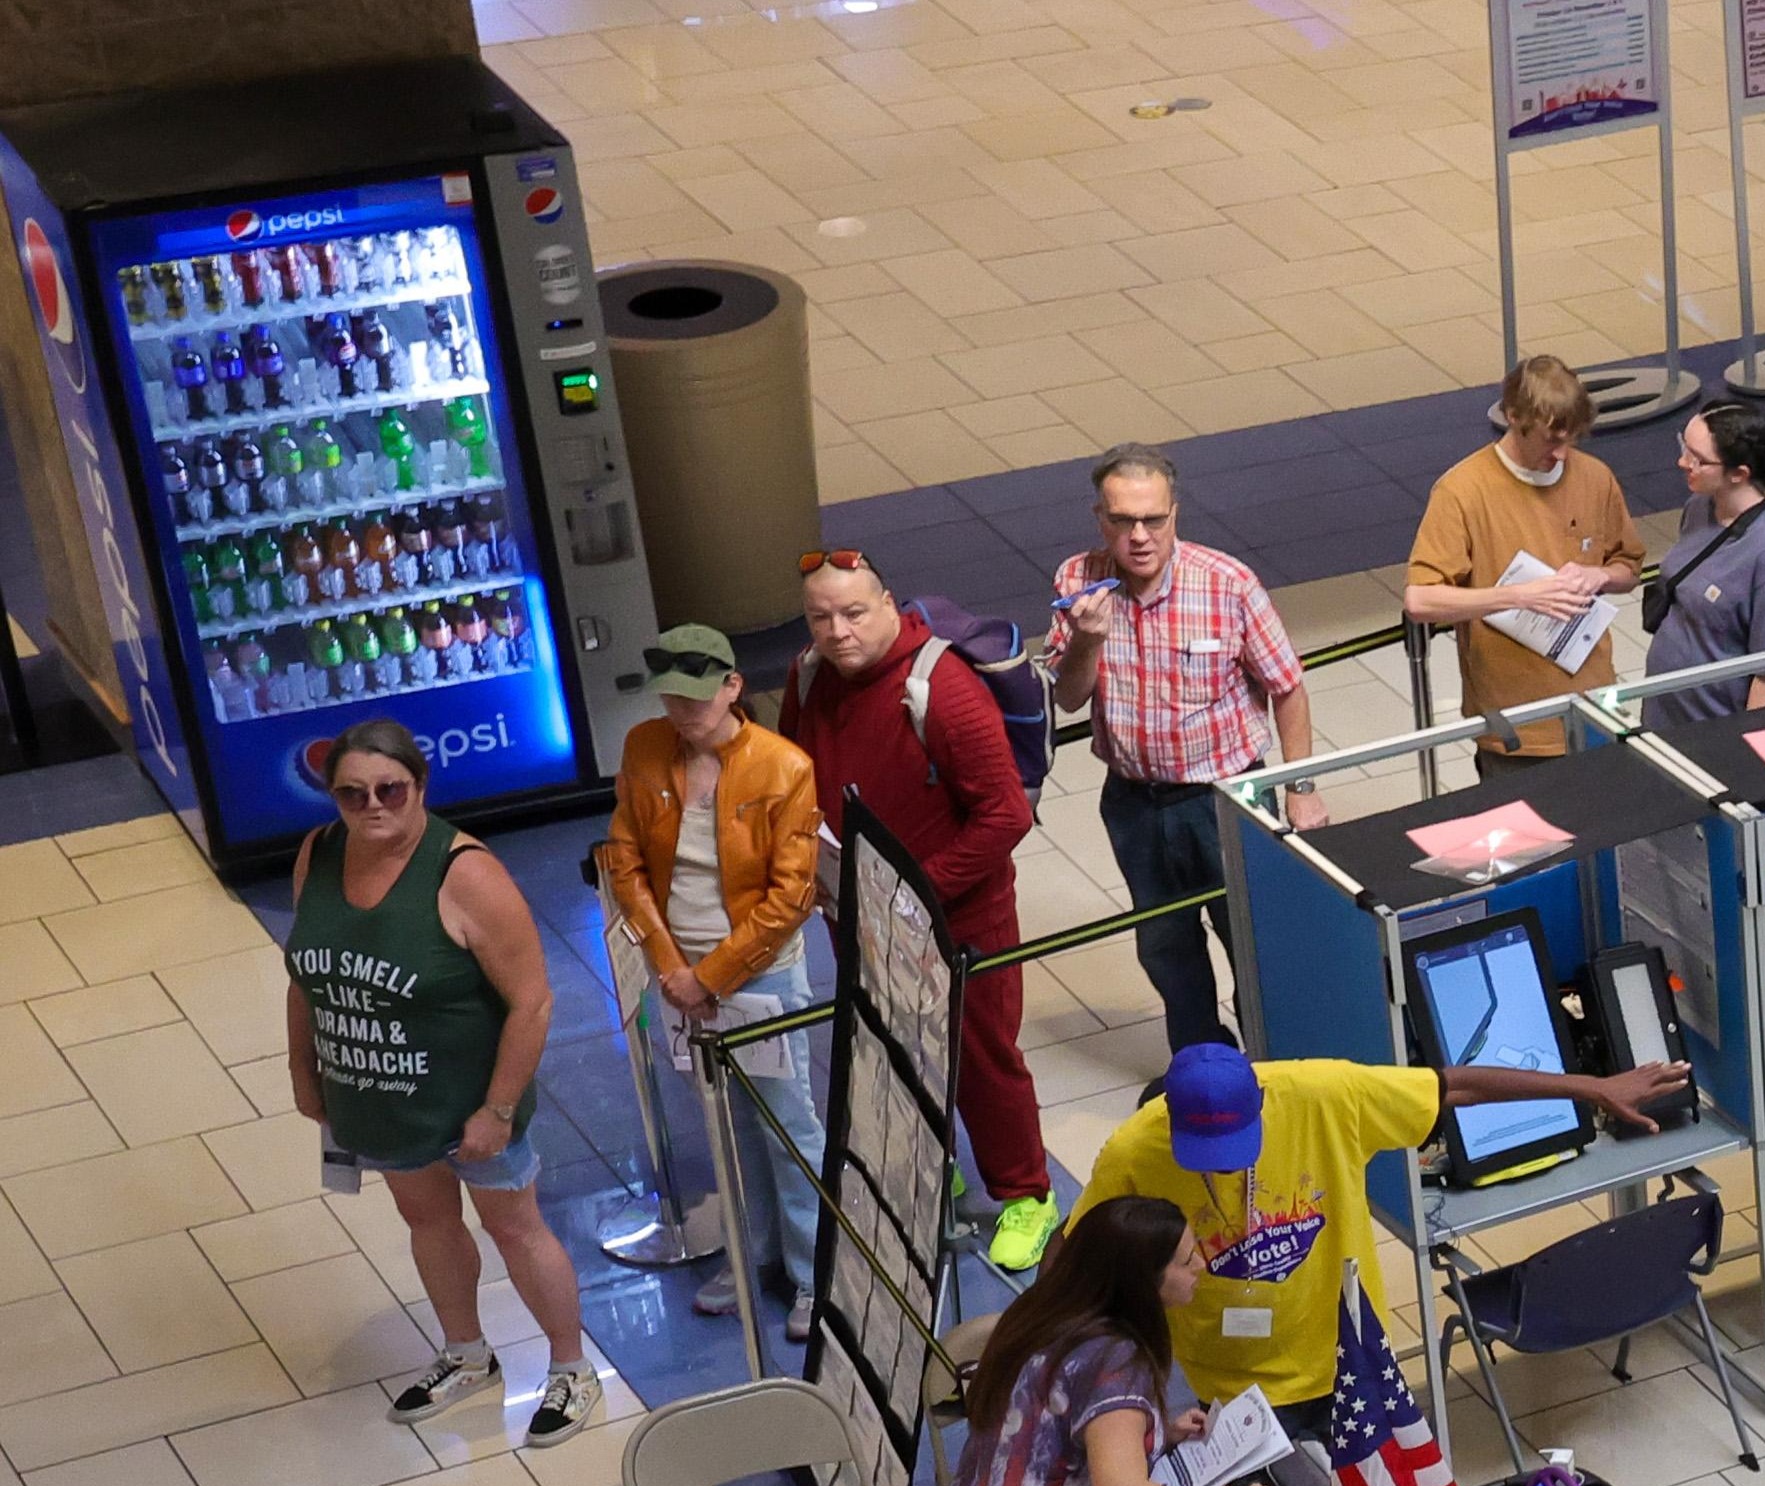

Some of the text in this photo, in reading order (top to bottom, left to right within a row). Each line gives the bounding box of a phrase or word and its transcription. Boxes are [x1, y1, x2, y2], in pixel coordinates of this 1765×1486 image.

[268, 203, 343, 235] pepsi
[72, 419, 177, 778] pepsi
[413, 712, 509, 769] epsi
[291, 948, 419, 999] YOU SMELL
[314, 1006, 408, 1045] DRAMA &
[1210, 1246, 1239, 1272] Don't
[1265, 1223, 1292, 1238] Your
[1294, 1216, 1321, 1232] Voice
[1244, 1234, 1300, 1267] Vote!
